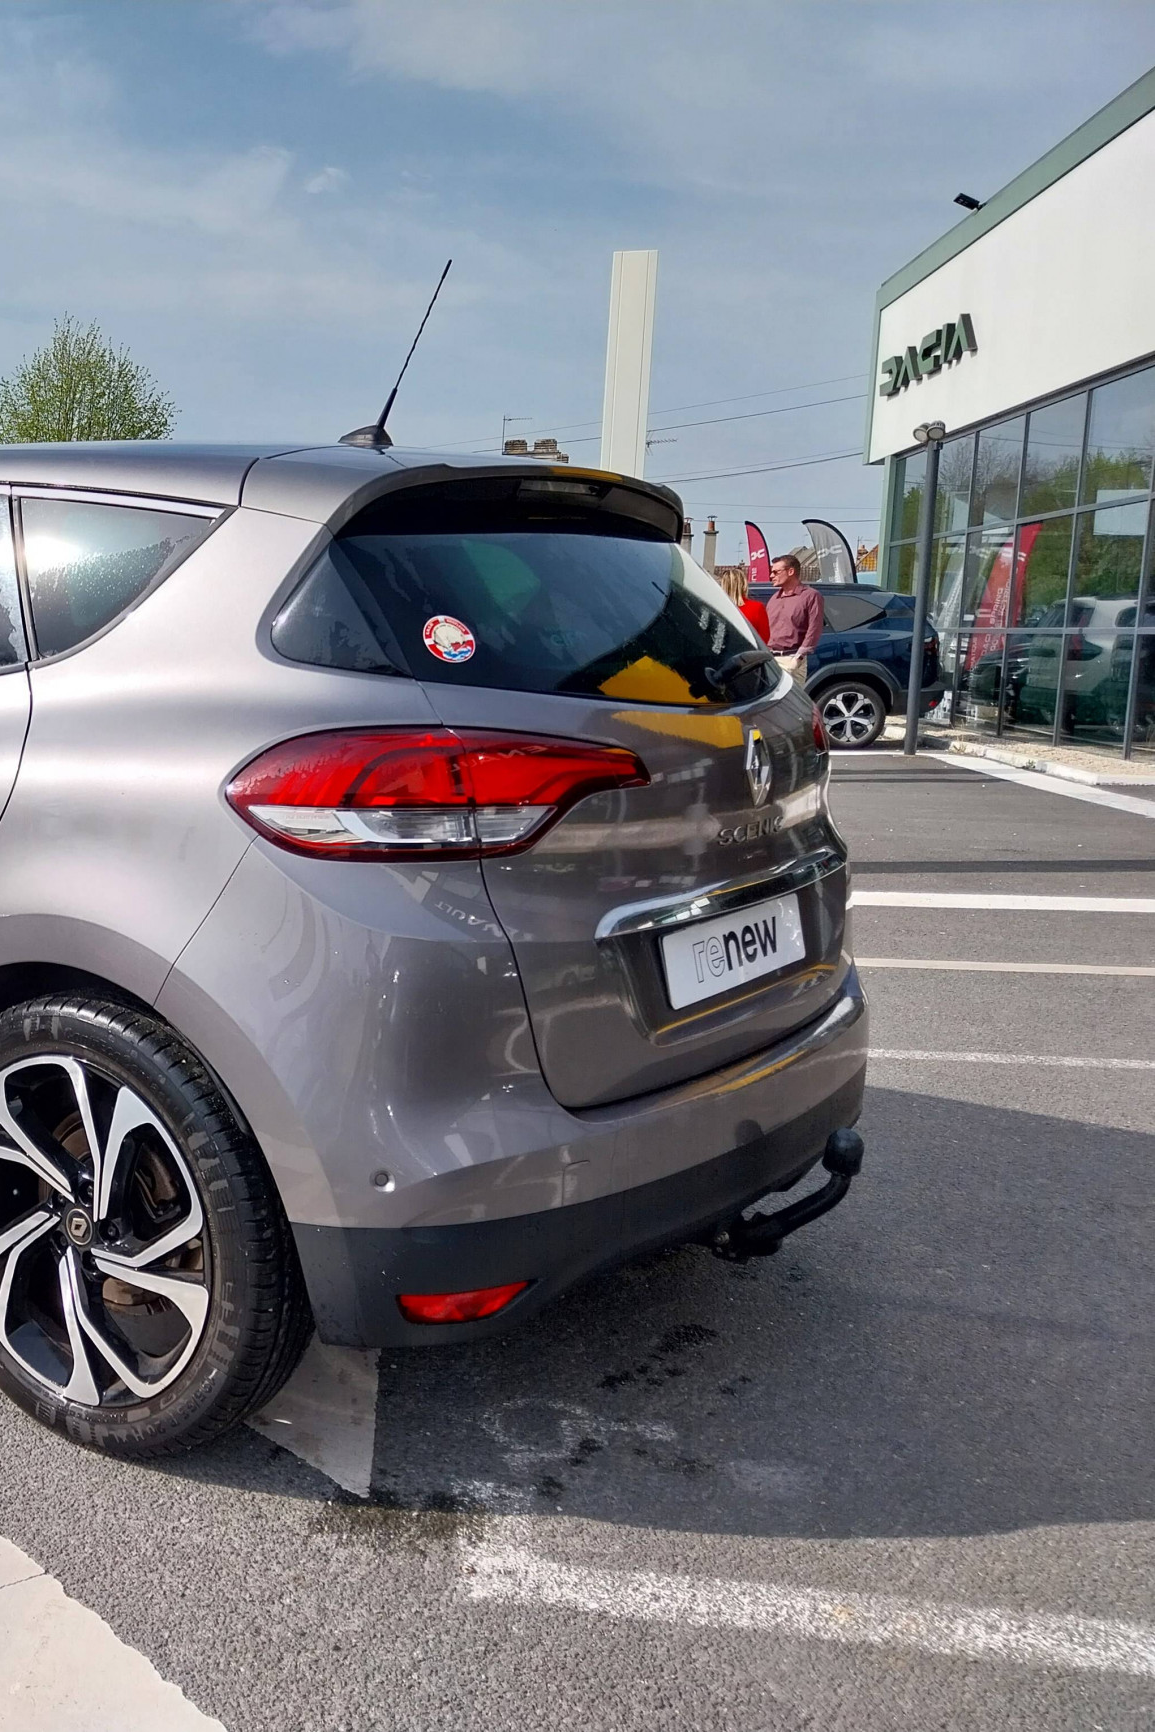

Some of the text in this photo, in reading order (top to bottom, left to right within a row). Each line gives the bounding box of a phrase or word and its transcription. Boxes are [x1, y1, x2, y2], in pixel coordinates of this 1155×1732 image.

[879, 313, 978, 397] DACIA
[718, 816, 784, 846] SCENIC
[692, 916, 777, 984] renew
